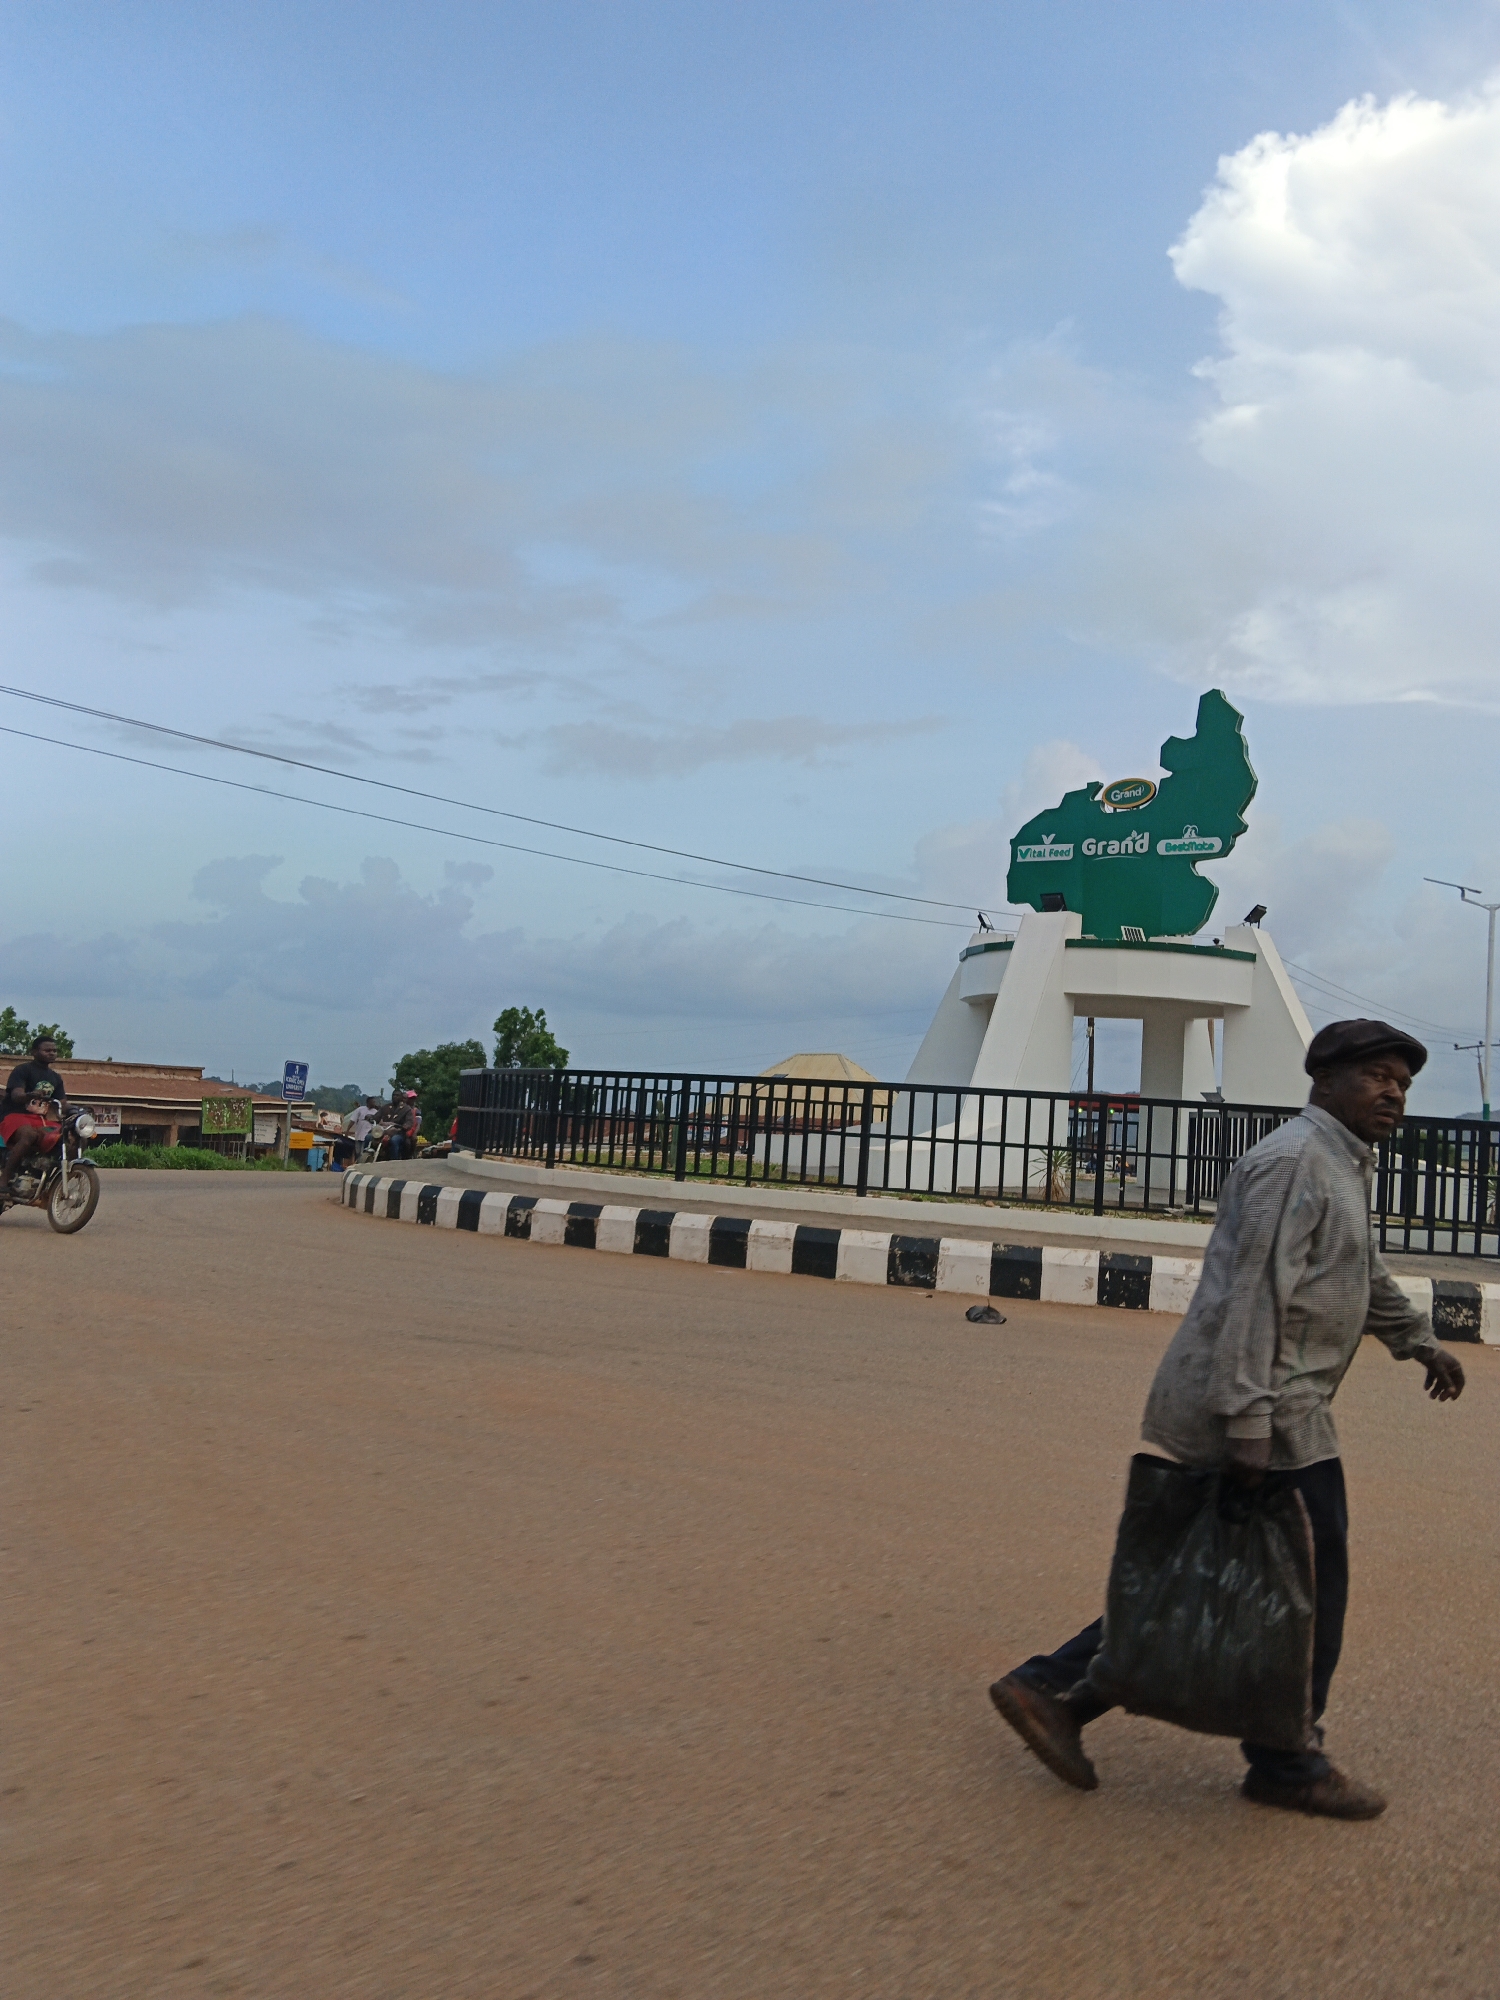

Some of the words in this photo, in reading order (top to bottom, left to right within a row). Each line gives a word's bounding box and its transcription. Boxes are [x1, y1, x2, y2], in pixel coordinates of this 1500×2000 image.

[1111, 787, 1142, 801] Grand
[1081, 831, 1150, 855] Grand
[1018, 847, 1046, 859] Vital
[1049, 847, 1071, 857] Feed
